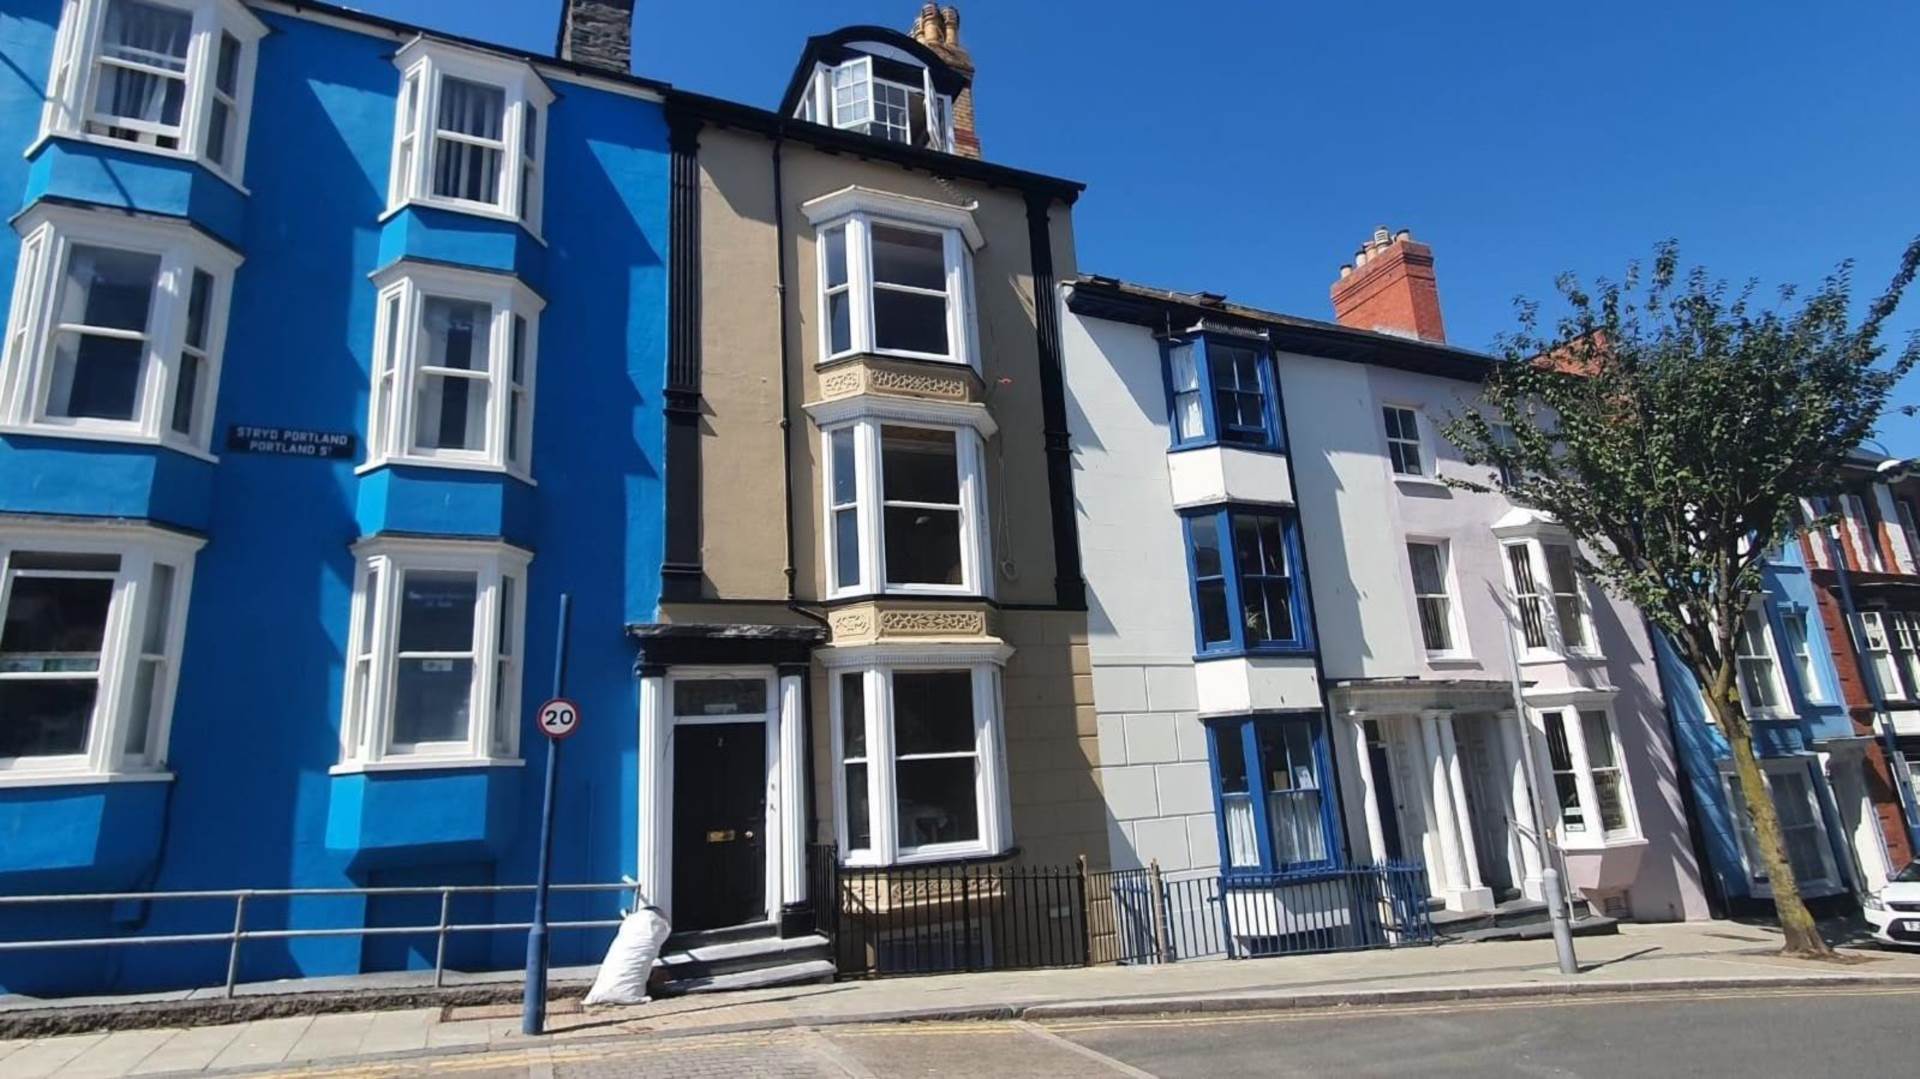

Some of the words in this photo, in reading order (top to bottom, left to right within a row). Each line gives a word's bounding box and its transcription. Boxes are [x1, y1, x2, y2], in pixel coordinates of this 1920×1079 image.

[237, 427, 278, 440] STRYD
[283, 430, 348, 445] PORTLAND
[249, 441, 316, 455] PORTLAND
[545, 709, 573, 726] 20
